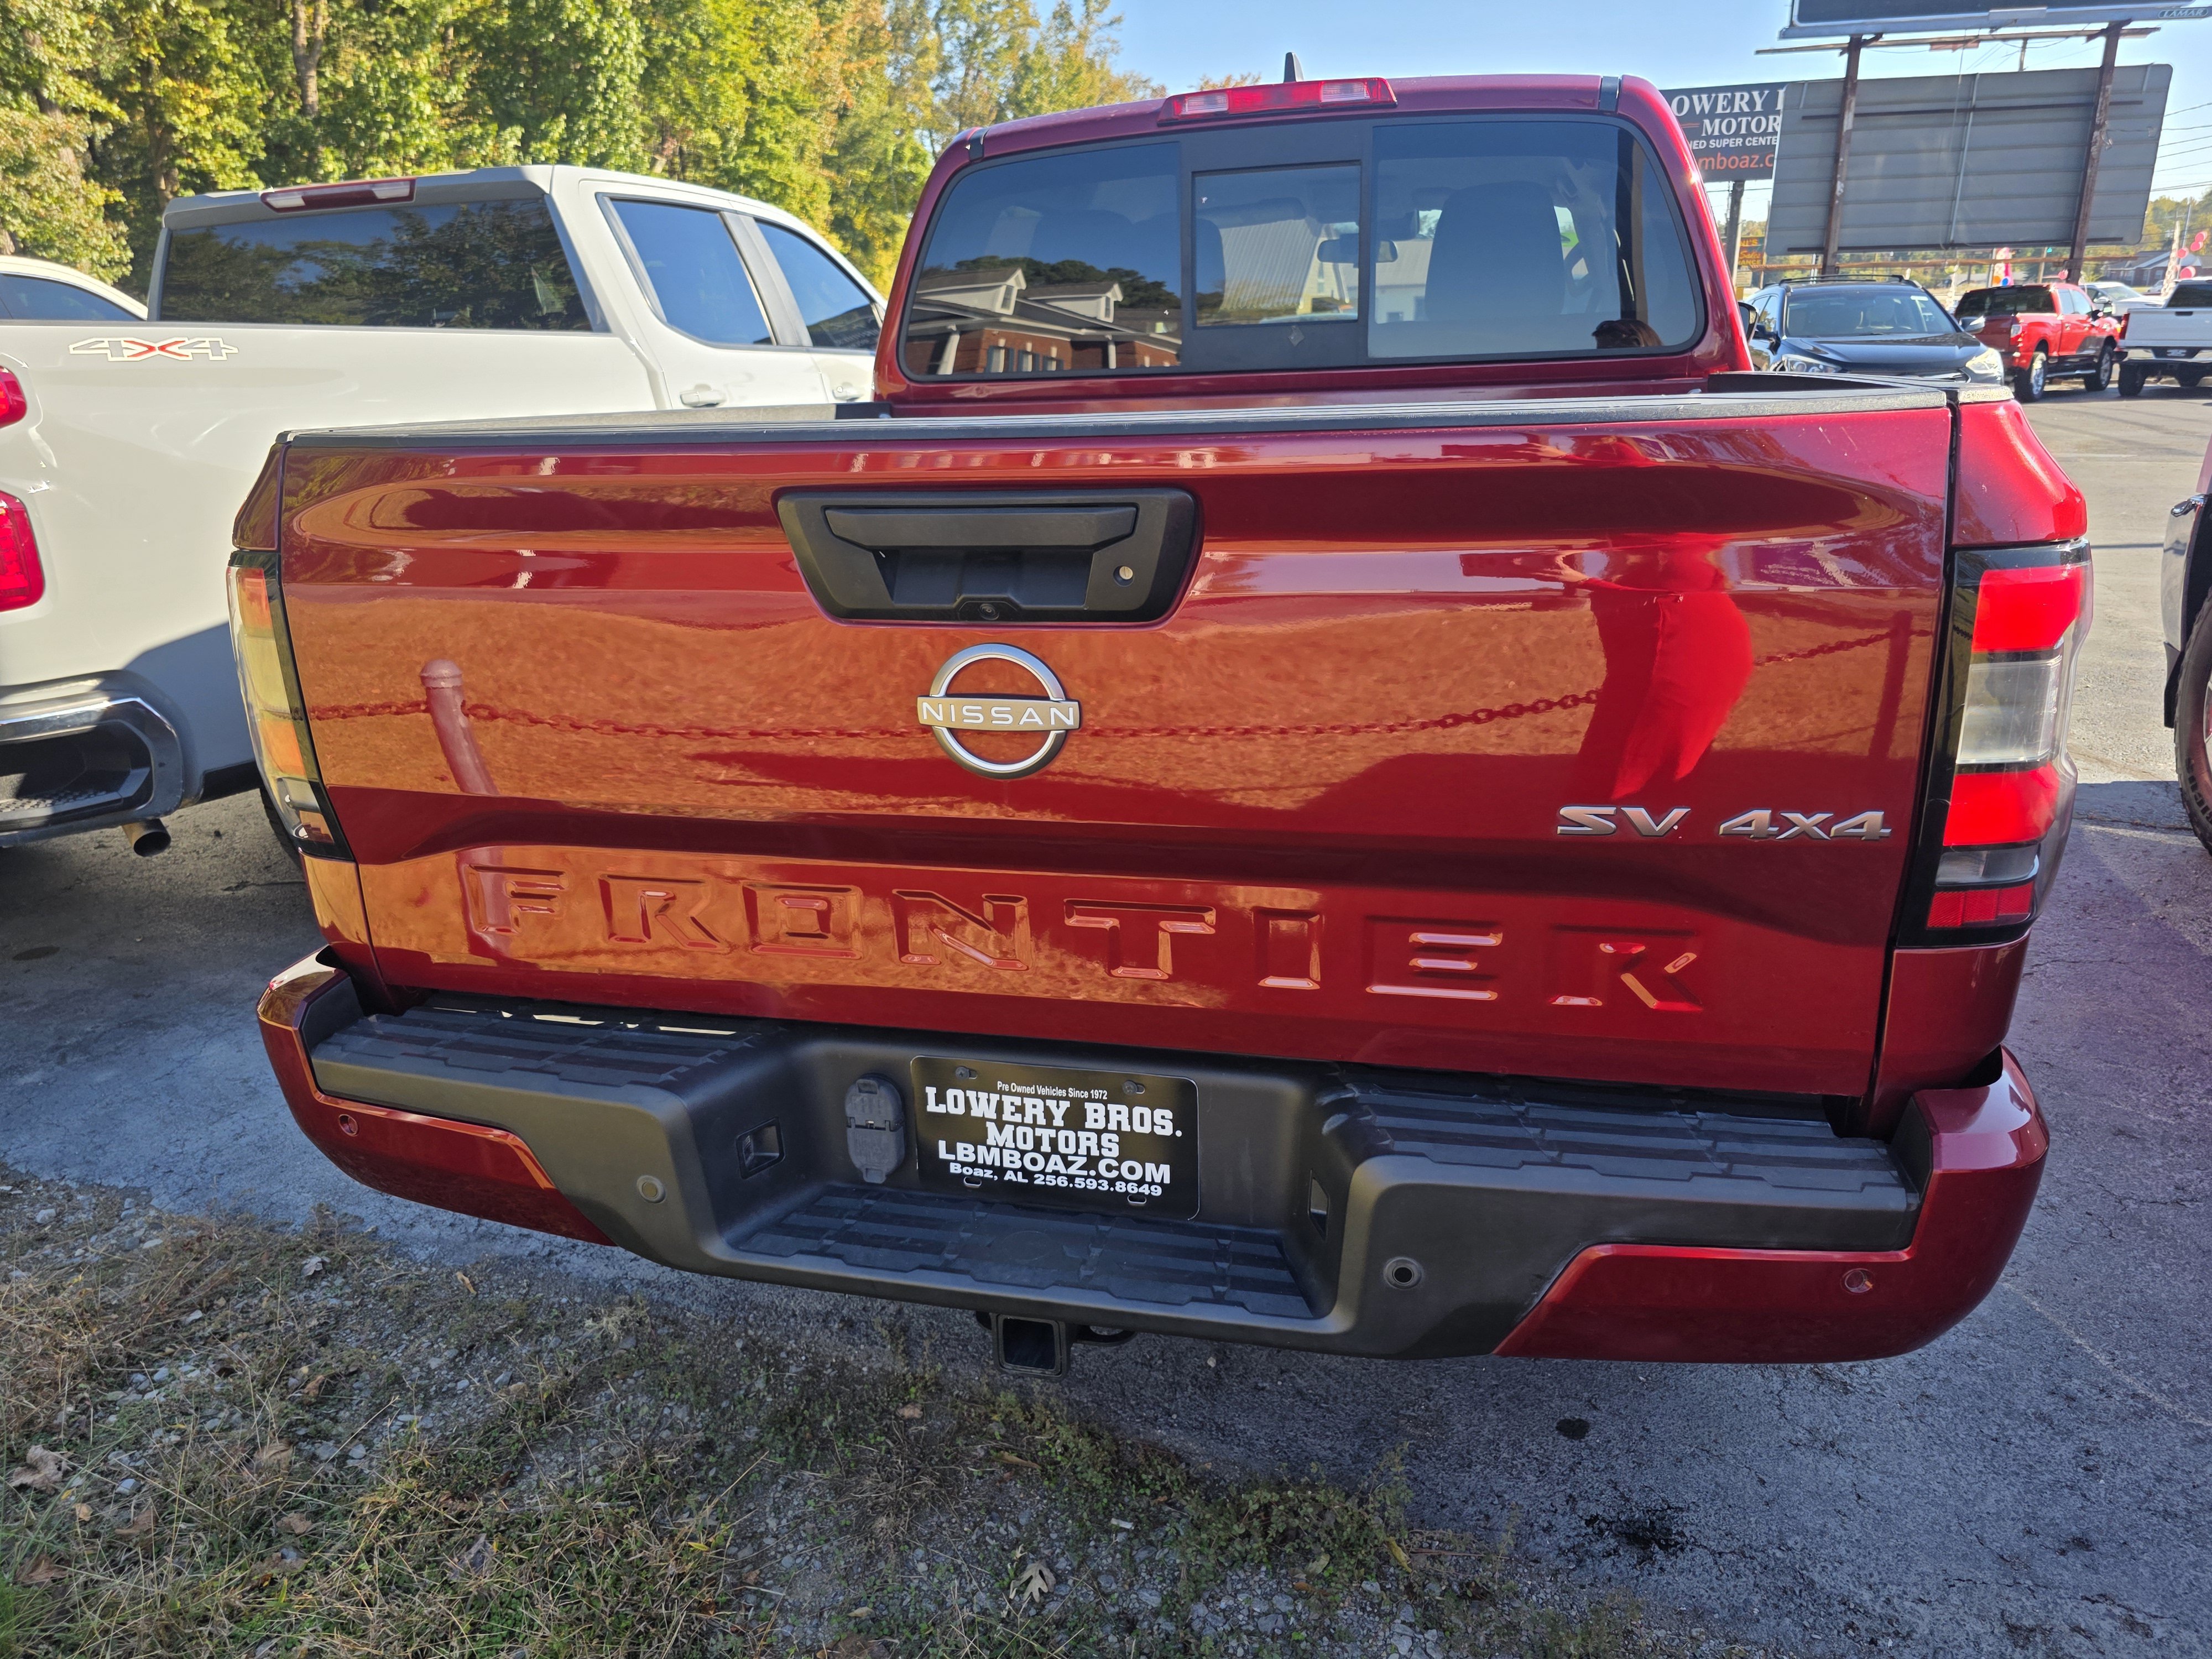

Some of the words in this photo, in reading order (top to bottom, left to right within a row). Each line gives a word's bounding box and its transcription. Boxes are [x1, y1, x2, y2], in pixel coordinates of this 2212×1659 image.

[2163, 8, 2204, 17] LAMAR
[1709, 138, 1743, 148] SUPER
[922, 702, 1074, 726] NISSAN
[1557, 805, 1691, 837] SV
[466, 863, 1704, 1012] FRONTIER
[997, 1081, 1009, 1092] Pre
[1010, 1082, 1035, 1094] Owned
[1036, 1084, 1067, 1097] Vehicles
[1068, 1087, 1089, 1099] Since
[1090, 1089, 1108, 1100] 1972
[925, 1086, 1071, 1127] LOWERY
[1084, 1102, 1182, 1137] BROS.
[985, 1121, 1119, 1158] MOTORS
[938, 1140, 1170, 1184] LBMBOAZ.COM
[950, 1162, 998, 1181] Boaz,
[1003, 1170, 1029, 1183] AL
[1034, 1173, 1162, 1196] 256.593.8649
